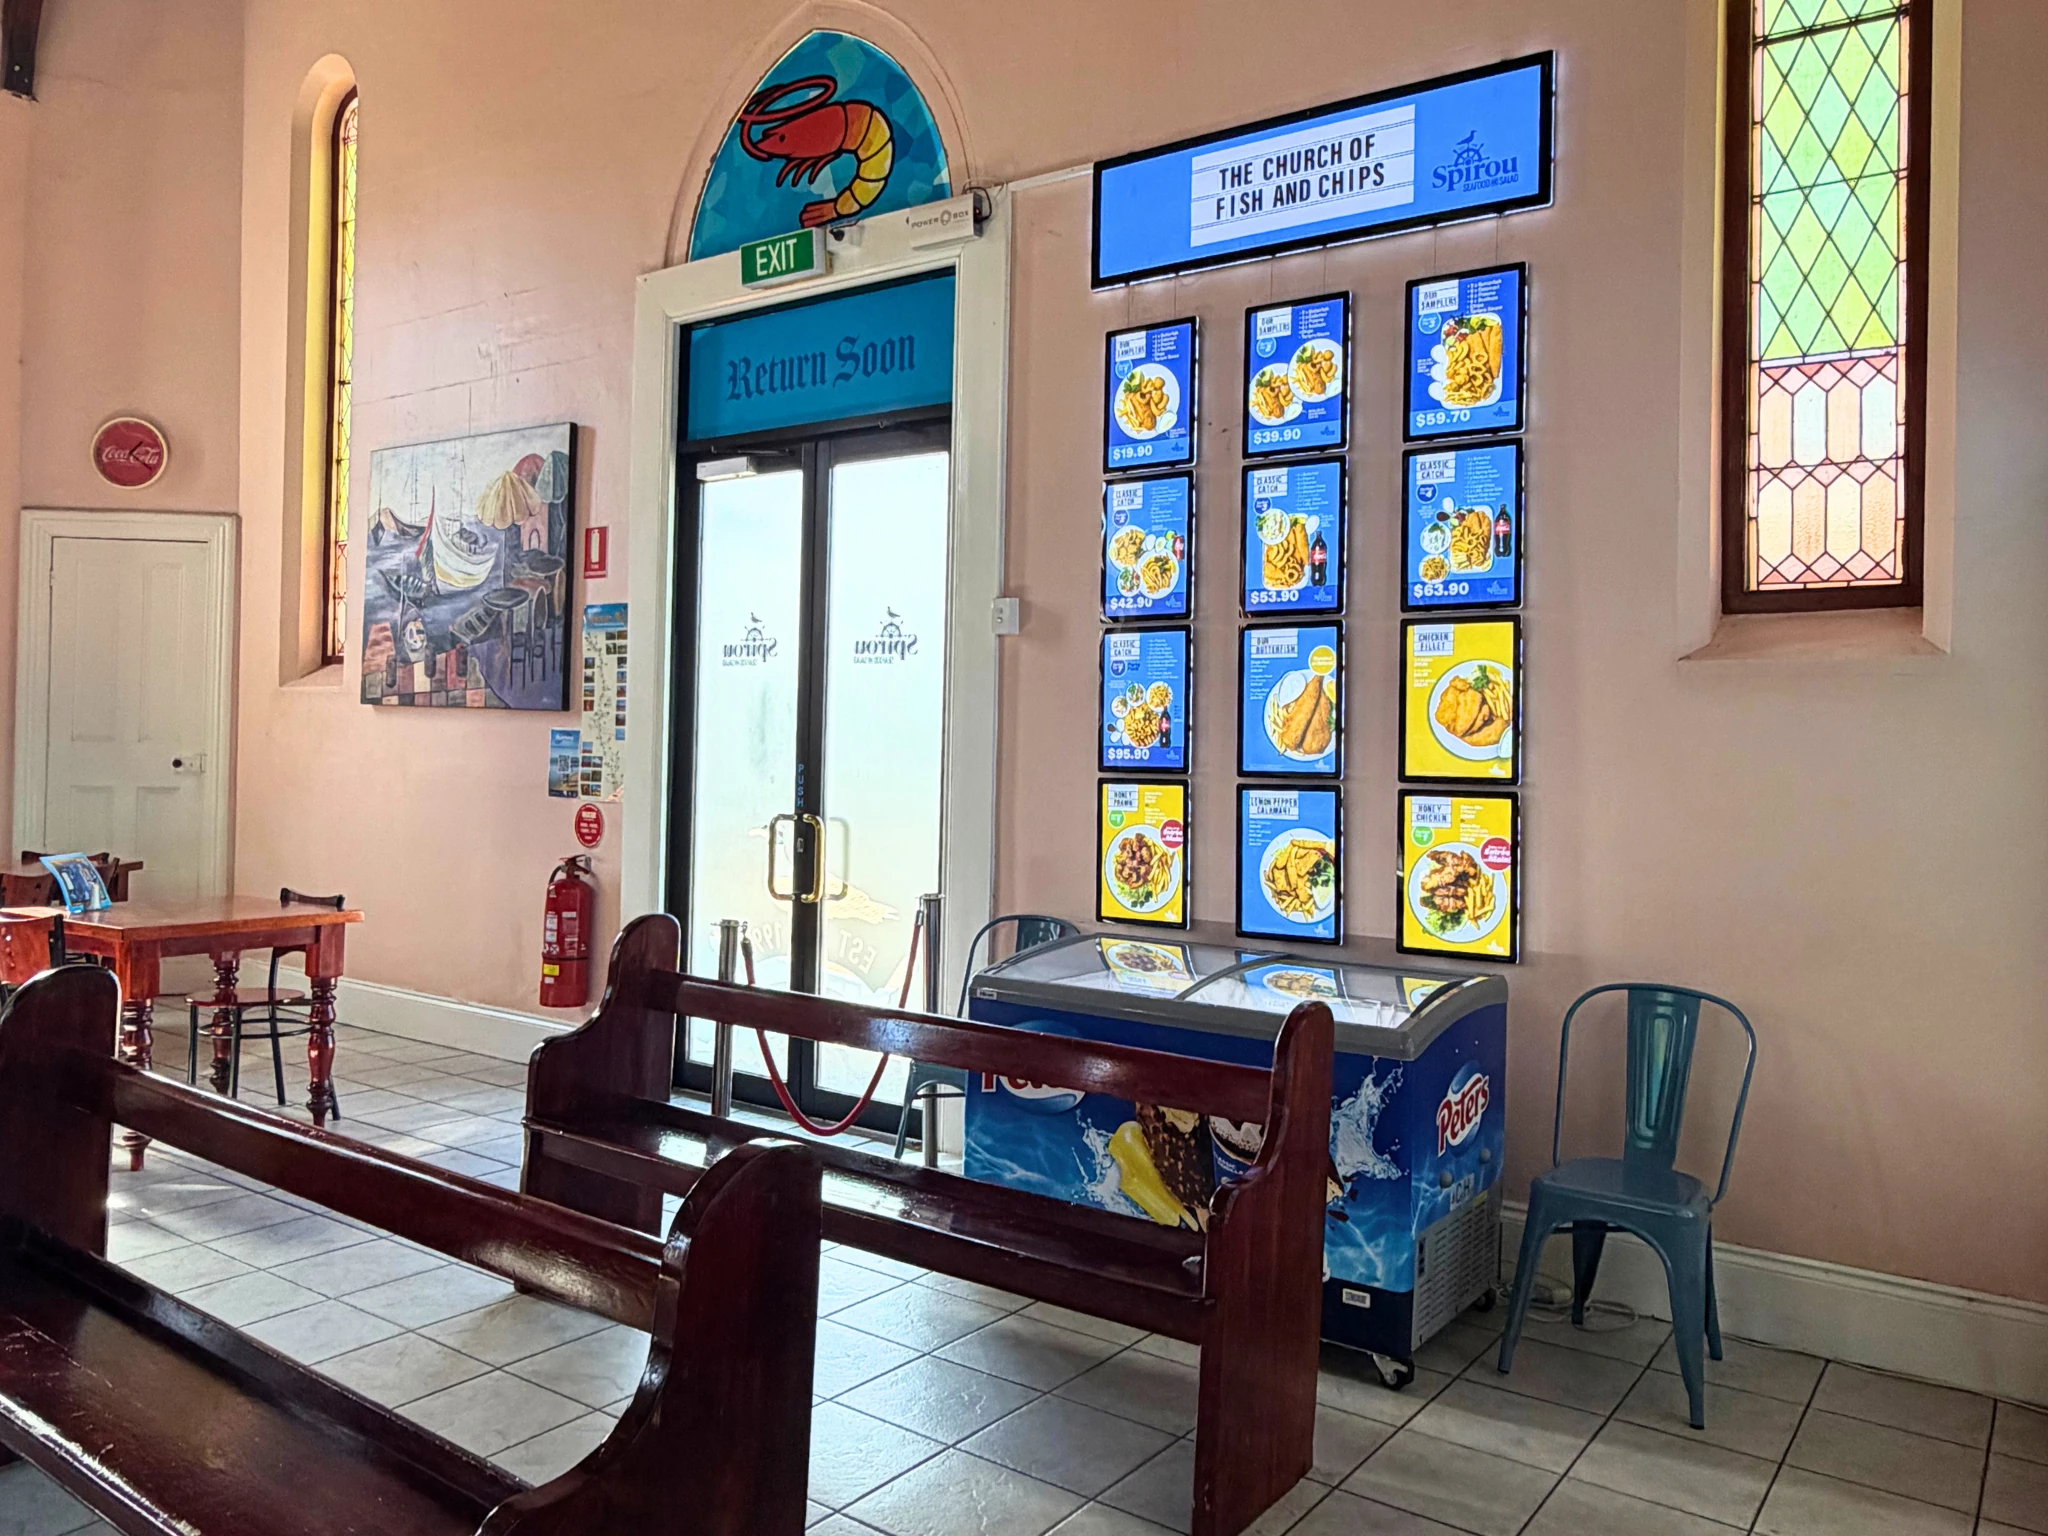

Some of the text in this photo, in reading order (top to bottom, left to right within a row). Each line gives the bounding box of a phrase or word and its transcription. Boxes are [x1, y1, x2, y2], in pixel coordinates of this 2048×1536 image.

[1219, 134, 1376, 190] THE CHURCH OF
[1432, 156, 1518, 192] Spirou
[1216, 163, 1385, 221] FISH AND CHIPS
[911, 210, 969, 229] POWER BOX
[755, 238, 798, 276] EXIT
[726, 334, 916, 401] Return Soon
[1415, 409, 1471, 428] $59.70
[1253, 428, 1301, 445] $39.90
[1113, 444, 1153, 461] $19.90
[1419, 461, 1449, 471] CLASSIC
[1256, 475, 1282, 485] CLASSIC
[1421, 471, 1445, 480] CATCH
[1250, 589, 1299, 605] $53.90
[1413, 582, 1470, 599] $63.90
[1110, 597, 1153, 611] $42.90
[1418, 632, 1449, 642] CHICKEN
[1420, 642, 1446, 651] FILLET
[1107, 747, 1150, 761] $95.90
[796, 764, 805, 807] PUSH
[1418, 804, 1442, 813] HONEY
[1437, 1074, 1489, 1156] Peters
